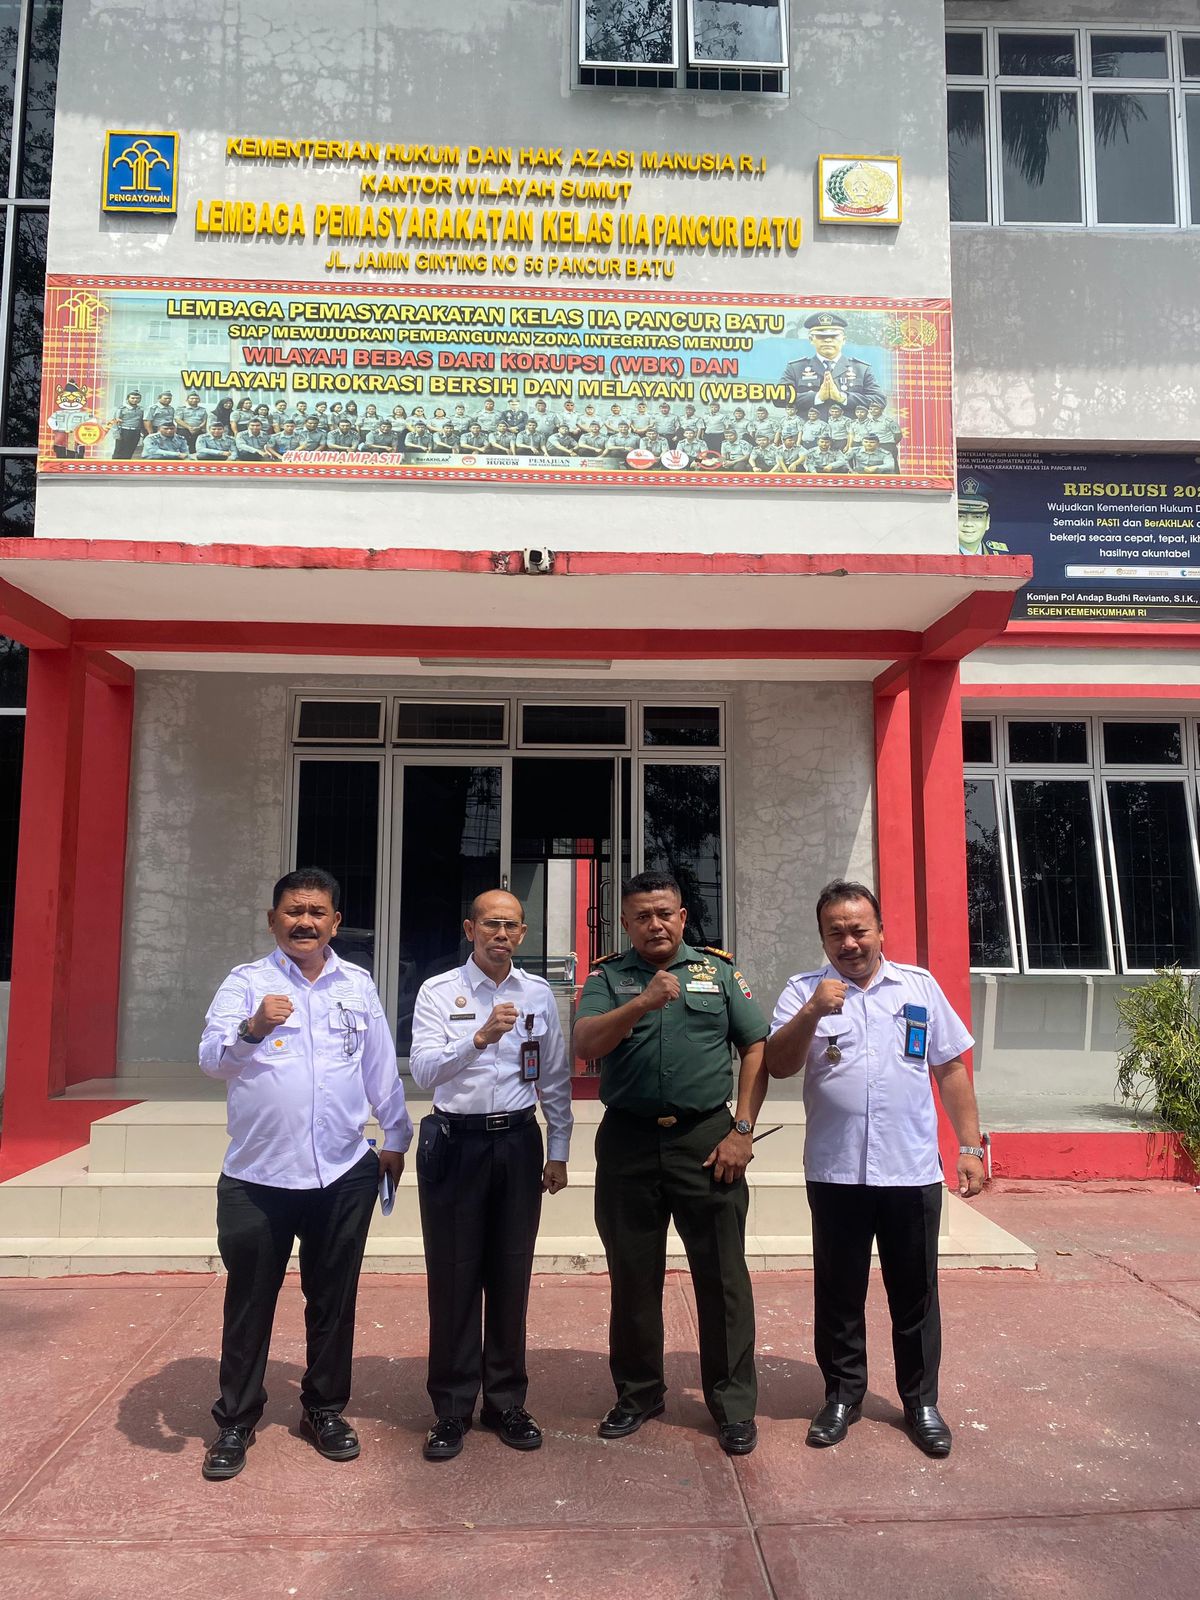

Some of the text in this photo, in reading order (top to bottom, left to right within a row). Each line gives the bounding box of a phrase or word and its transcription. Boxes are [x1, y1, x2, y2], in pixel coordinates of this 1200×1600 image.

[226, 137, 767, 173] KEMENTERIAN HUKUM DAN HAK AZASI MANUSIA R.I
[361, 174, 632, 199] KANTOR WILAYAH SUMUT
[109, 193, 170, 203] PENGAYOMAN
[195, 199, 802, 250] LEMBAGA PEMASYARAKATAN KELAS IIA PANCUR BATU
[325, 251, 676, 278] JL. JAMIN GINTING NO 56 PANCUR BATU
[167, 298, 785, 333] LEMBAGA PEMASYARAKATAN KELAS IIA PANCUR BATU
[228, 325, 753, 351] SIAP MEWUJUDKAN PEMBANGUNAN ZONA INTEGRITAS MENUJU
[242, 346, 739, 377] WILAYAH BEBAS DARI KORUPSI (WBK) DAN
[181, 370, 797, 403] WILAYAH BIROKRASI BERSIH DAN MELAYANI (WBBM)
[283, 451, 402, 464] #KUMHAMPASTI
[1063, 483, 1200, 498] RESOLUSI 20
[1047, 502, 1094, 513] Wujudkan
[1097, 503, 1157, 513] Kementerian
[1160, 504, 1193, 513] Hukum
[1053, 518, 1094, 527] Semakin
[1096, 518, 1120, 527] PASTI
[1122, 519, 1141, 527] dan
[1144, 519, 1194, 528] BerAKHLAK
[1049, 532, 1086, 543] bekerja
[1088, 534, 1122, 542] secara
[1124, 534, 1156, 544] cepat,
[1158, 534, 1188, 544] tepat,
[1099, 548, 1191, 559] hasilnya akuntabel
[1026, 592, 1199, 604] Komjen Pol Andap Budhi Revianto, S.I.K.,
[1026, 607, 1147, 617] SEKJEN KEMENKUMHAM RI
